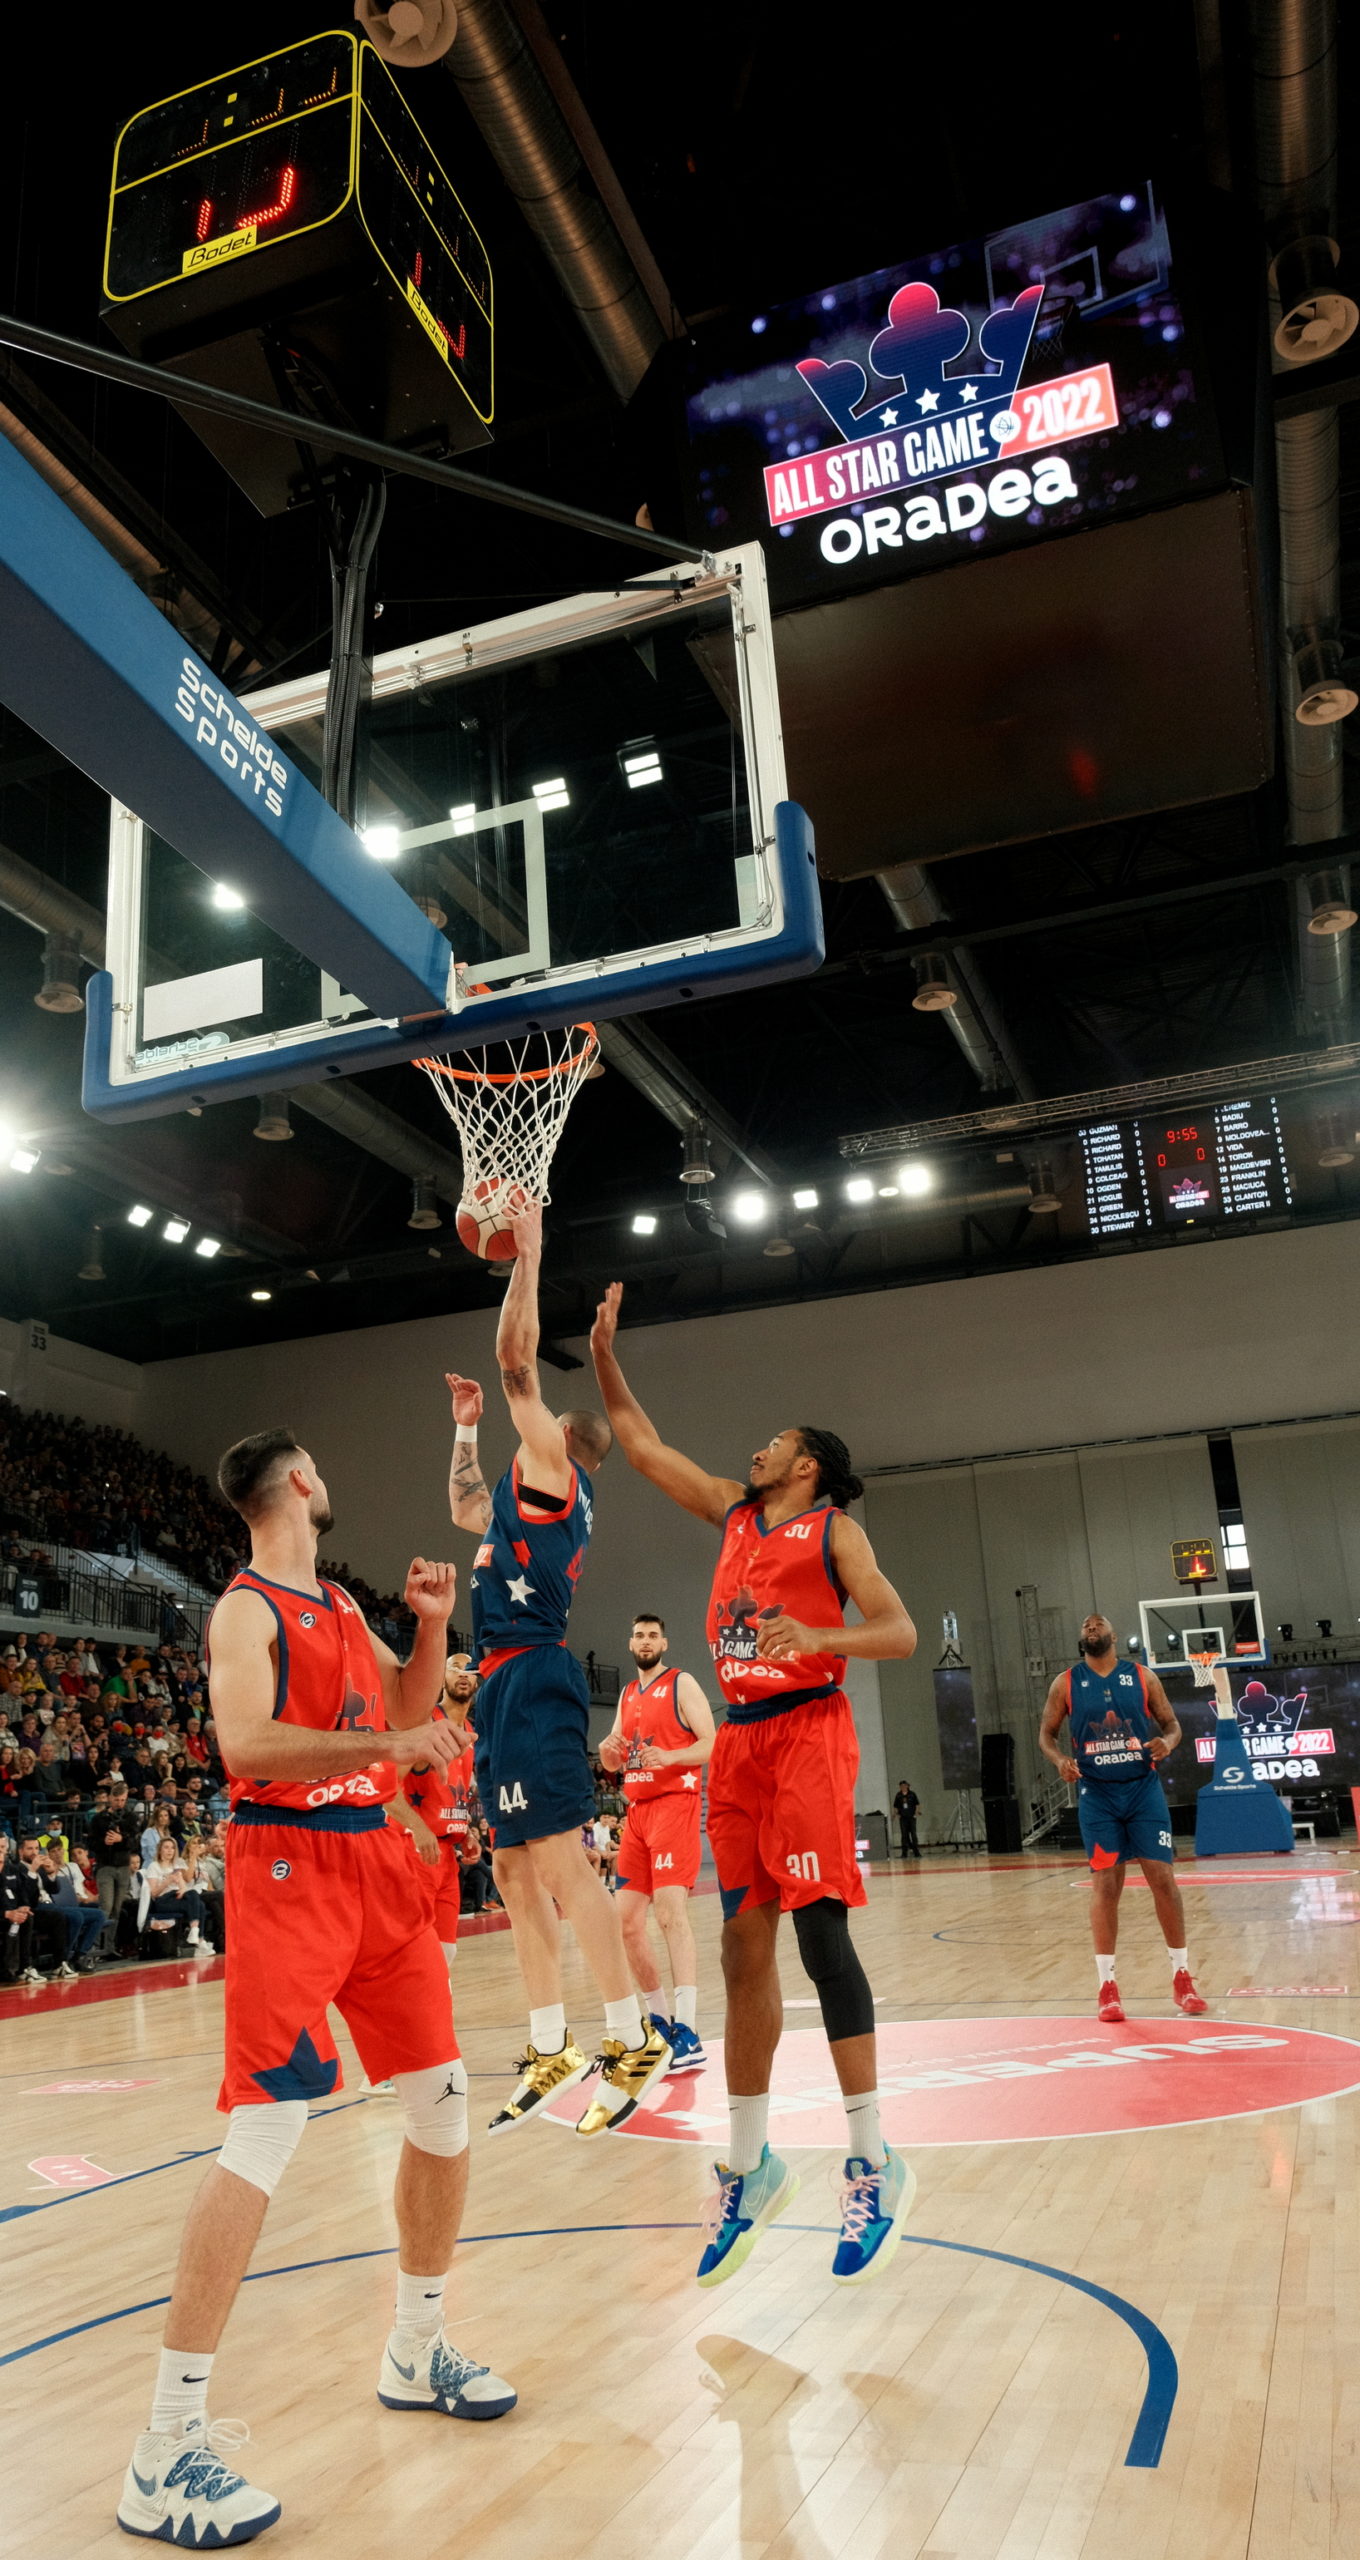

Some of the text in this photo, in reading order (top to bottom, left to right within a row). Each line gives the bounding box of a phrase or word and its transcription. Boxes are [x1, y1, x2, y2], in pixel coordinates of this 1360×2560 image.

[186, 230, 255, 270] Bodet
[410, 287, 448, 356] Bodet
[773, 381, 1104, 518] ALL STAR GAME 2022
[180, 657, 288, 787] Schelde
[175, 686, 283, 817] Sports
[1222, 1113, 1244, 1122] BADIU
[1089, 1124, 1118, 1135] GUZMAN
[1223, 1122, 1248, 1132] BARRO
[1090, 1134, 1120, 1144] RICHARD
[1167, 1127, 1198, 1143] 9:55
[1091, 1143, 1122, 1154] RICHARD
[1227, 1143, 1244, 1151] VIDA
[1157, 1147, 1205, 1167] 0 0
[1228, 1152, 1253, 1161] TOROK
[1094, 1163, 1122, 1173] TAMULIS
[1231, 1169, 1266, 1181] FRANKLIN
[1096, 1183, 1121, 1193] OGDEN
[1098, 1193, 1123, 1203] HOGUE
[1234, 1190, 1268, 1202] CLANTON
[1099, 1203, 1123, 1213] GREEN
[1236, 1201, 1265, 1212] CARTER
[1100, 1210, 1139, 1223] NICOLESCU
[1102, 1221, 1135, 1233] STEWART
[31, 1334, 46, 1351] 33
[20, 1590, 38, 1610] 10
[725, 1641, 756, 1660] GAME
[1119, 1674, 1133, 1686] 33
[652, 1686, 667, 1698] 44
[1086, 1743, 1096, 1753] ALL
[1096, 1742, 1110, 1752] STAR
[1252, 1735, 1286, 1755] GAME
[1298, 1732, 1330, 1752] 2022
[498, 1782, 529, 1814] 44
[1158, 1830, 1172, 1848] 33
[654, 1852, 675, 1871] 44
[786, 1851, 820, 1882] 30
